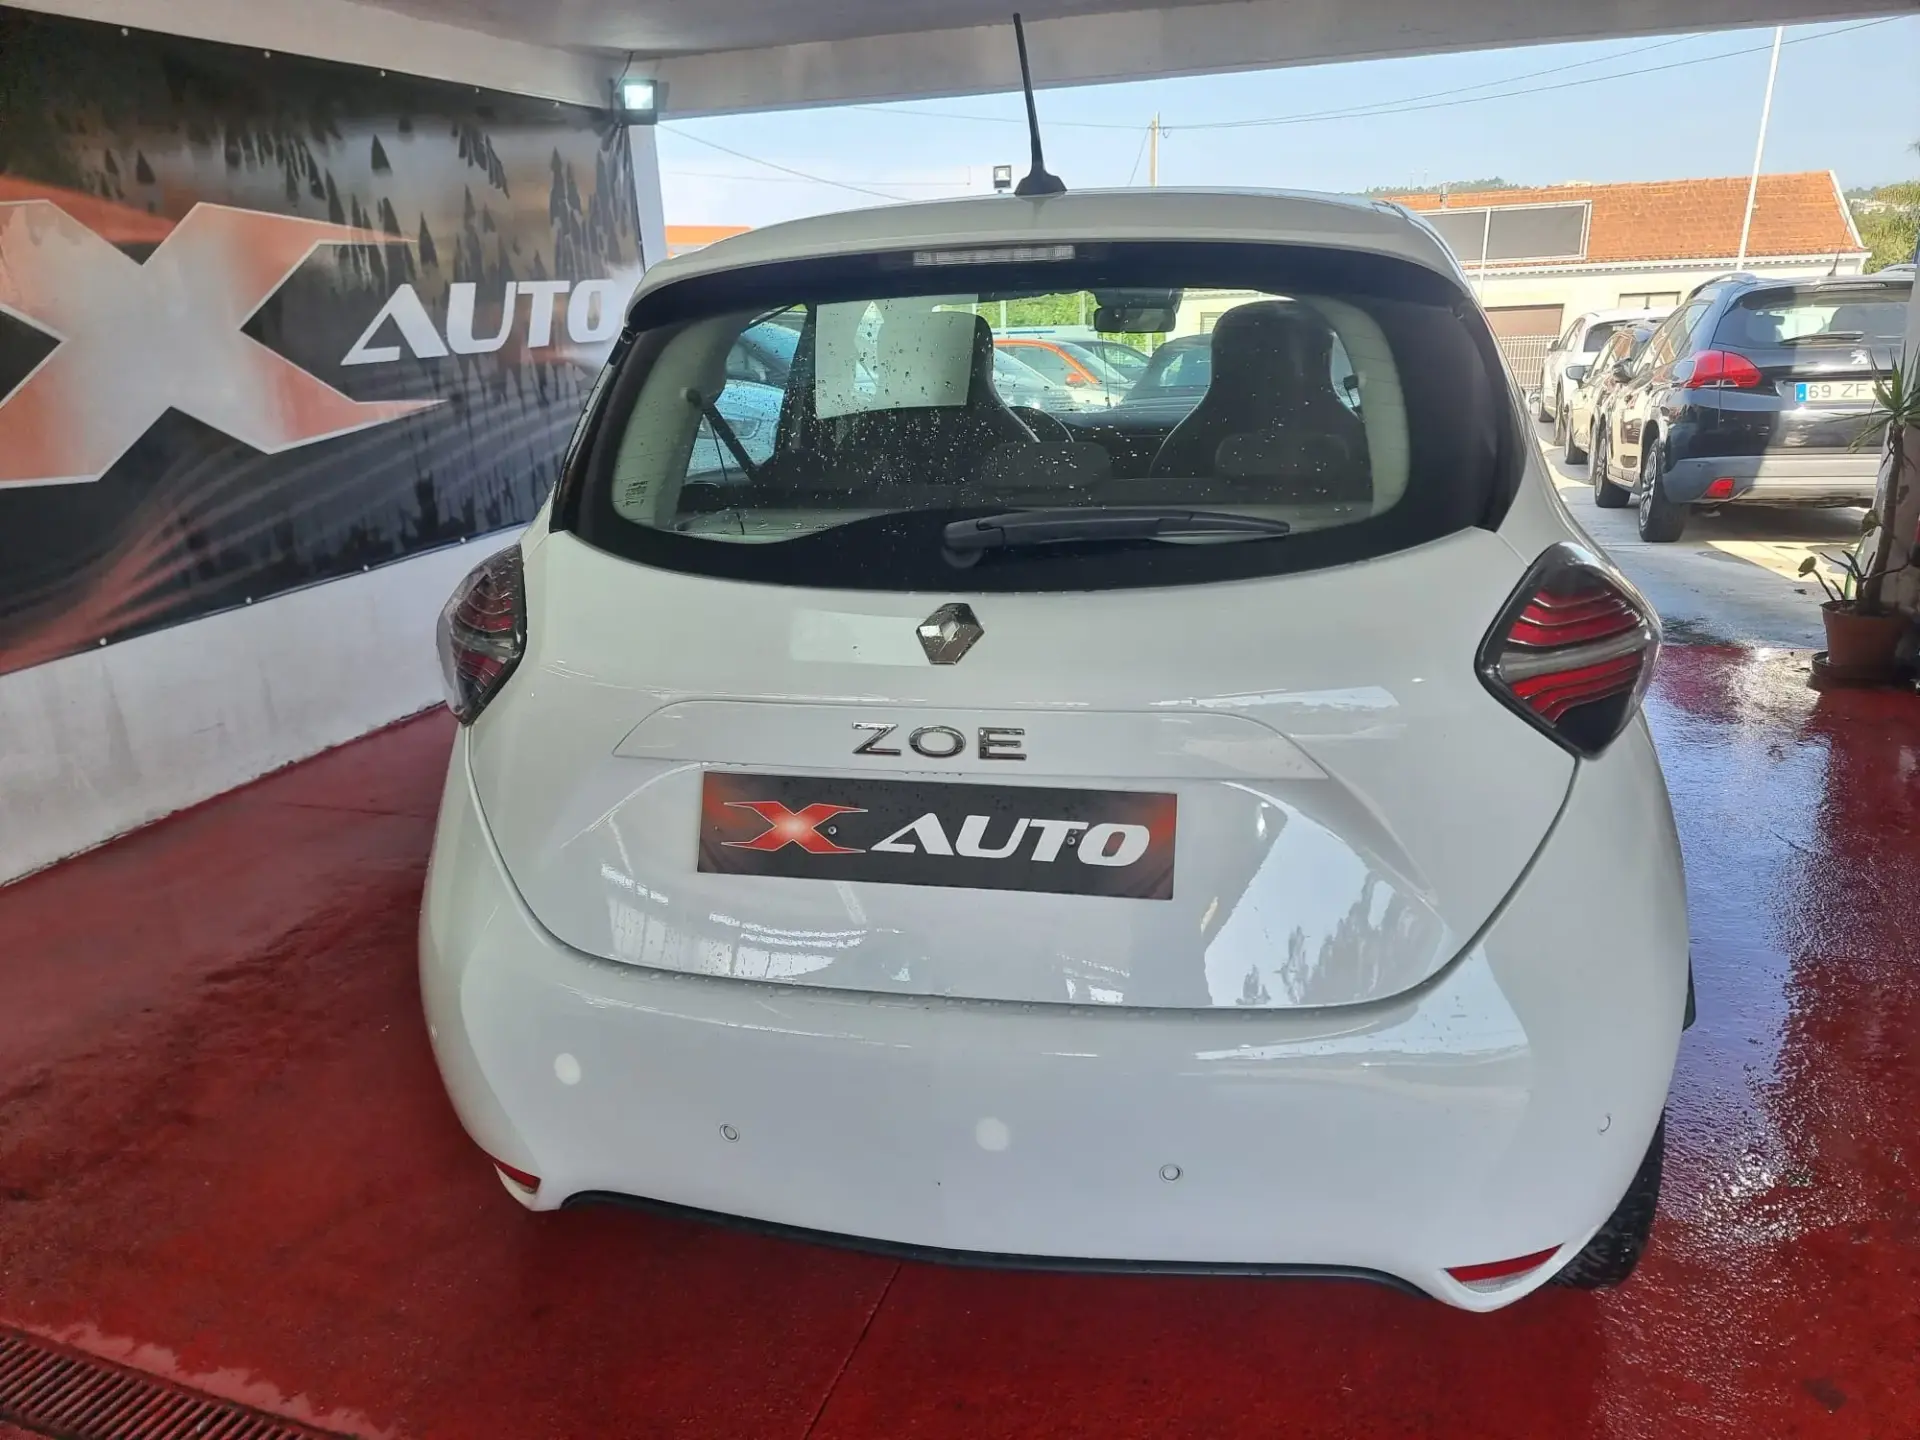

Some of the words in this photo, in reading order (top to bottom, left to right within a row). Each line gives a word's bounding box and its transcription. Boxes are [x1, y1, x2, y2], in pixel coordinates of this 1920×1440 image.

[339, 279, 622, 366] AUTO
[1808, 384, 1832, 399] 69
[1840, 383, 1869, 398] ZF
[851, 721, 1028, 761] ZOE
[720, 800, 869, 855] X
[869, 812, 1151, 868] AUTO
